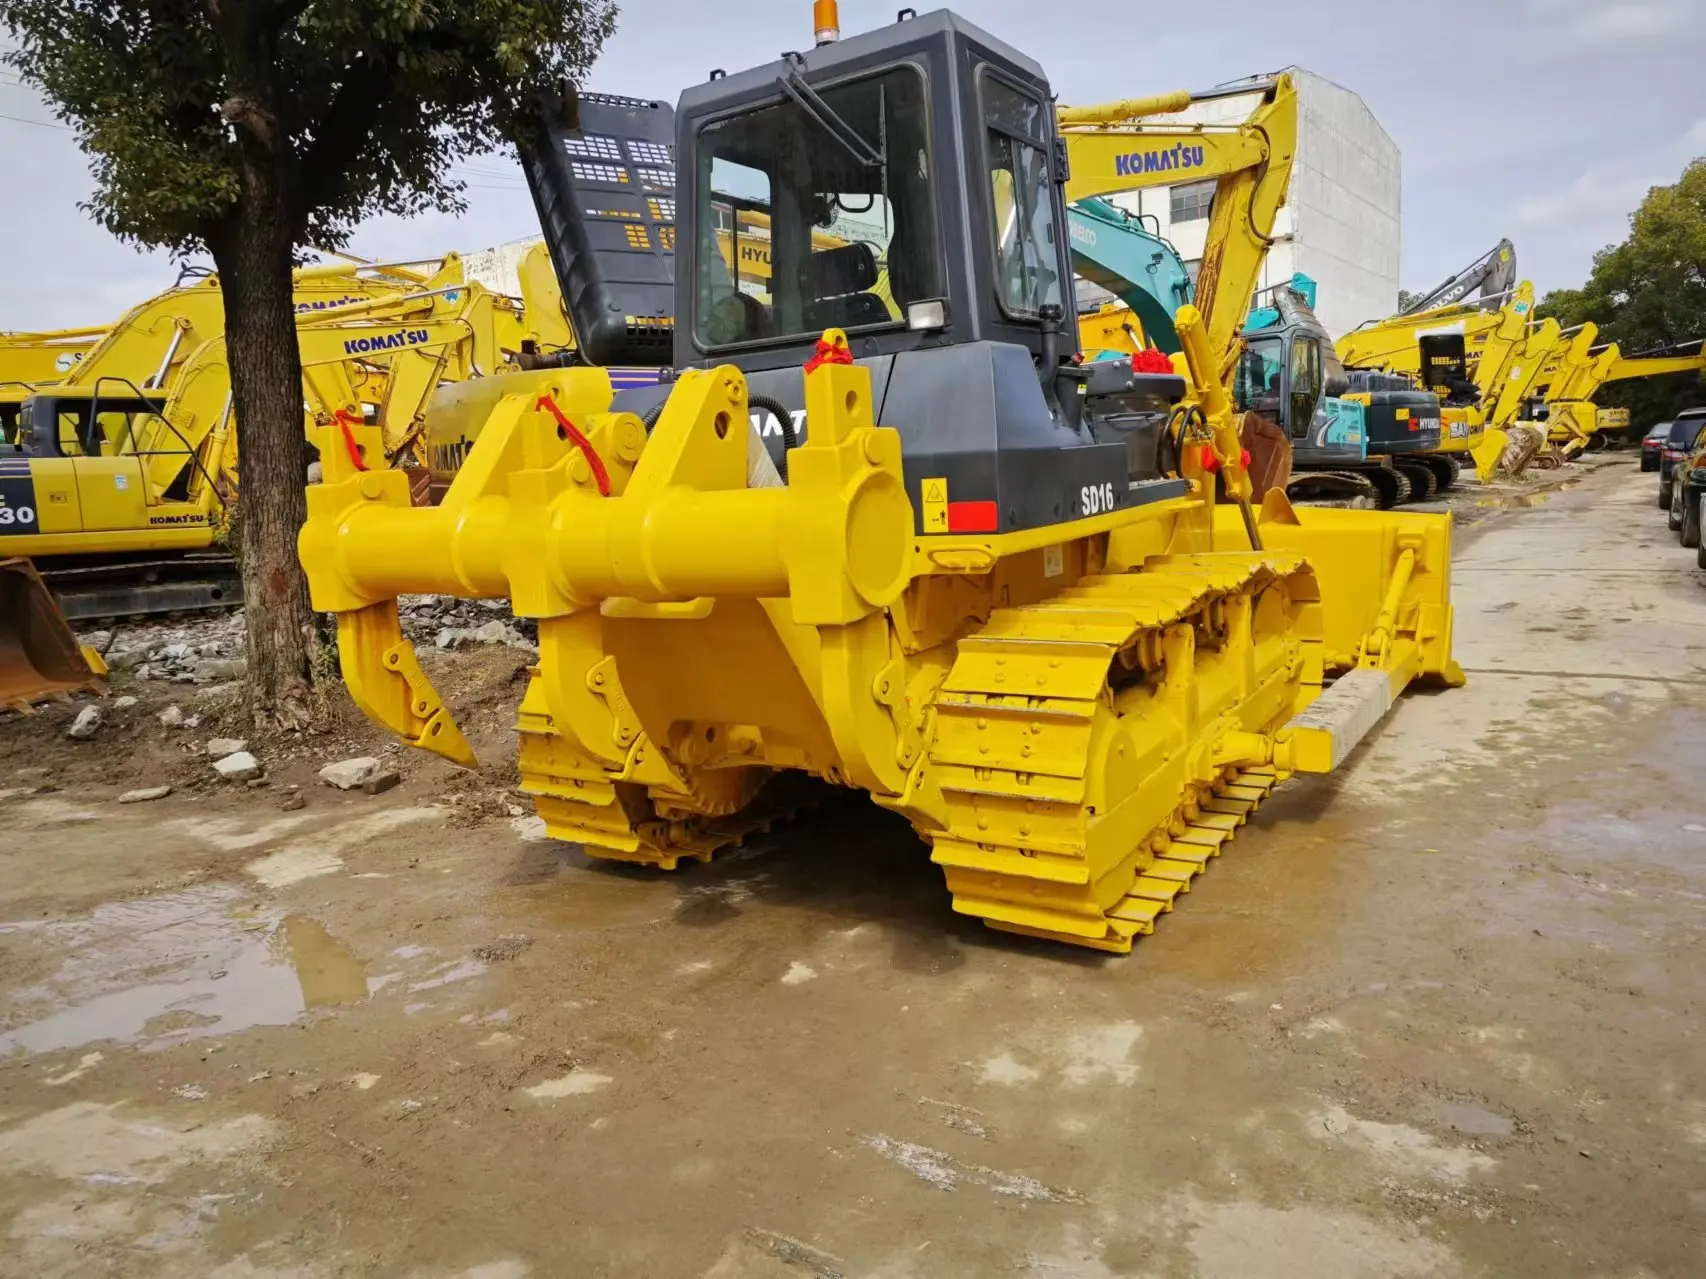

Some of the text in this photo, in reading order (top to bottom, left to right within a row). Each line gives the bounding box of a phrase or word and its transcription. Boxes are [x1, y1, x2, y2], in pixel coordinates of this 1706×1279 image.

[1115, 142, 1204, 177] KOMATSU
[1425, 285, 1464, 313] OLVO
[344, 329, 429, 354] KOMATSU
[1081, 482, 1114, 516] SD16
[0, 506, 35, 524] 30
[150, 514, 204, 525] KOMATSU
